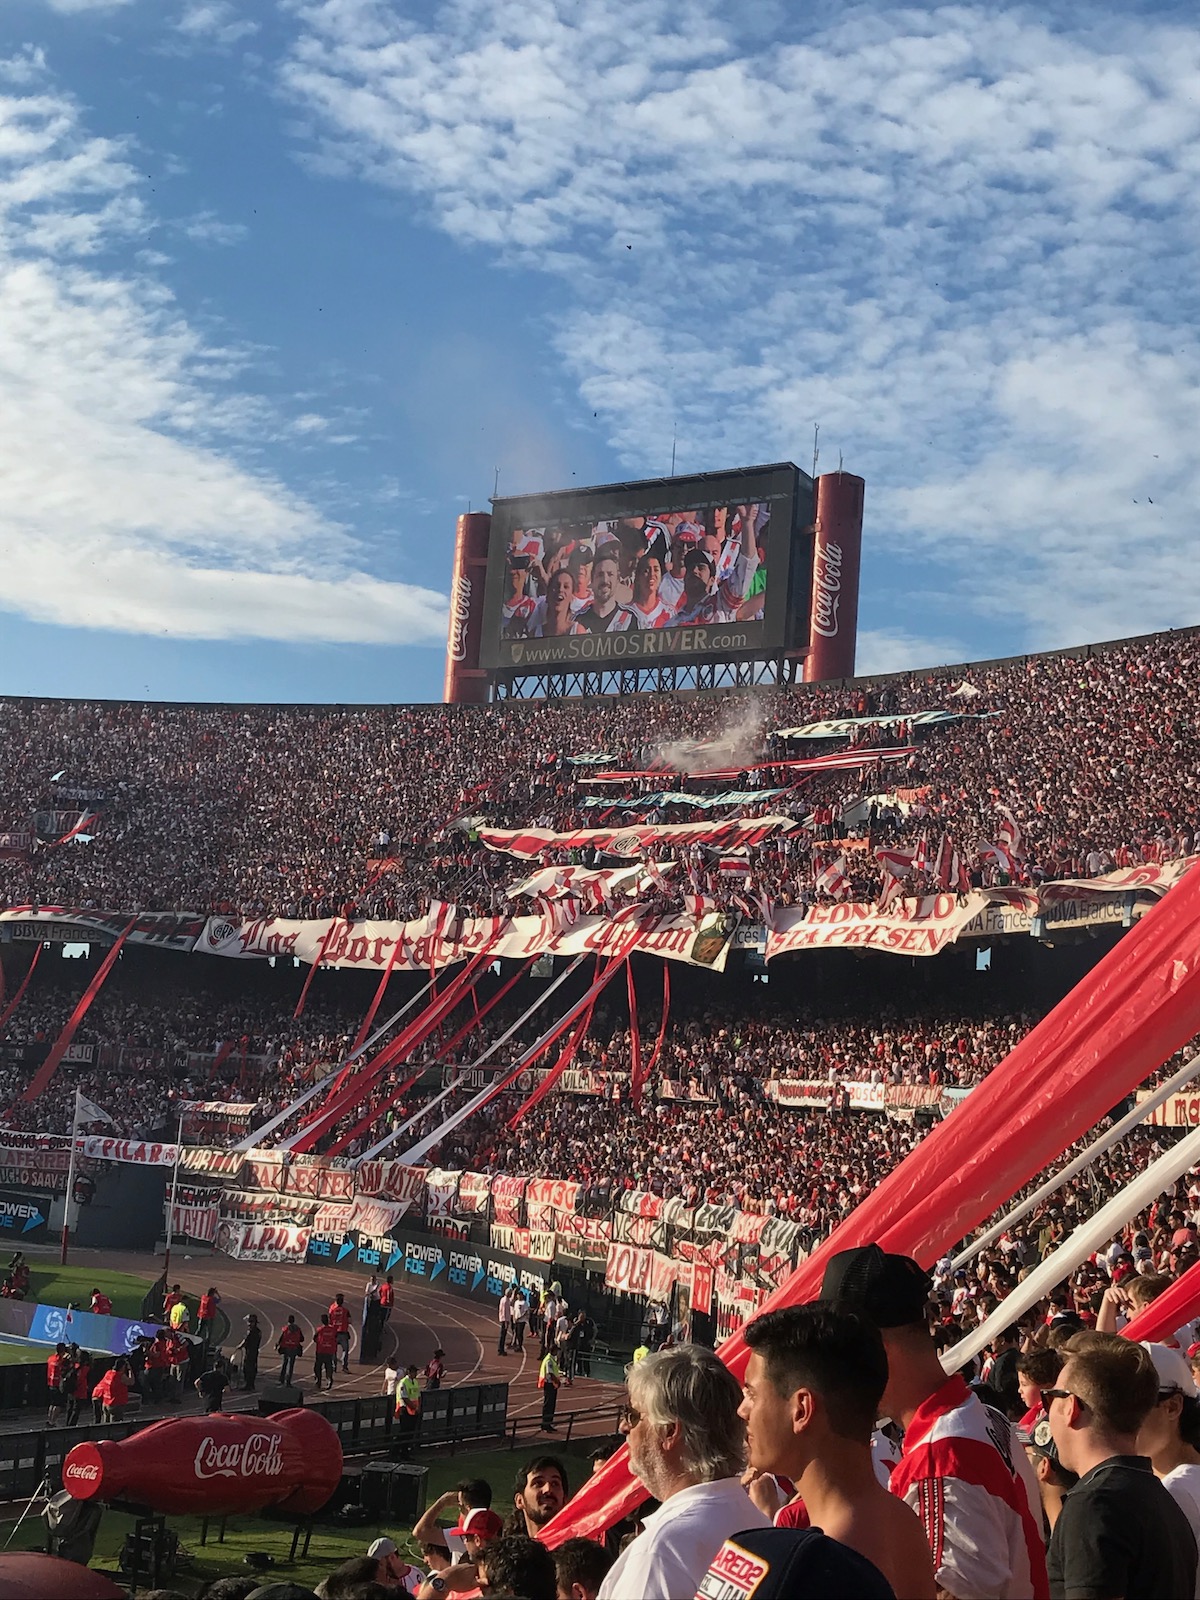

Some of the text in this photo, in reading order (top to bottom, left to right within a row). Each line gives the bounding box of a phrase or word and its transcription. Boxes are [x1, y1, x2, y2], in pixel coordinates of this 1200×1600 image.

[525, 629, 747, 662] www.SOMOSRIVER.com
[102, 1139, 163, 1164] PILAR
[359, 1161, 383, 1192] SAN
[384, 1163, 426, 1200] JUSTO
[405, 1242, 442, 1263] POWER
[491, 1228, 552, 1257] VILLA DE MAYO
[358, 1248, 381, 1265] ADE
[404, 1258, 426, 1275] ADE
[449, 1251, 483, 1273] POWER
[448, 1267, 467, 1286] ADE
[487, 1260, 516, 1281] POWER
[486, 1277, 503, 1296] ADE
[194, 1433, 284, 1480] Coca-Cola
[66, 1463, 99, 1480] Coca-Cola
